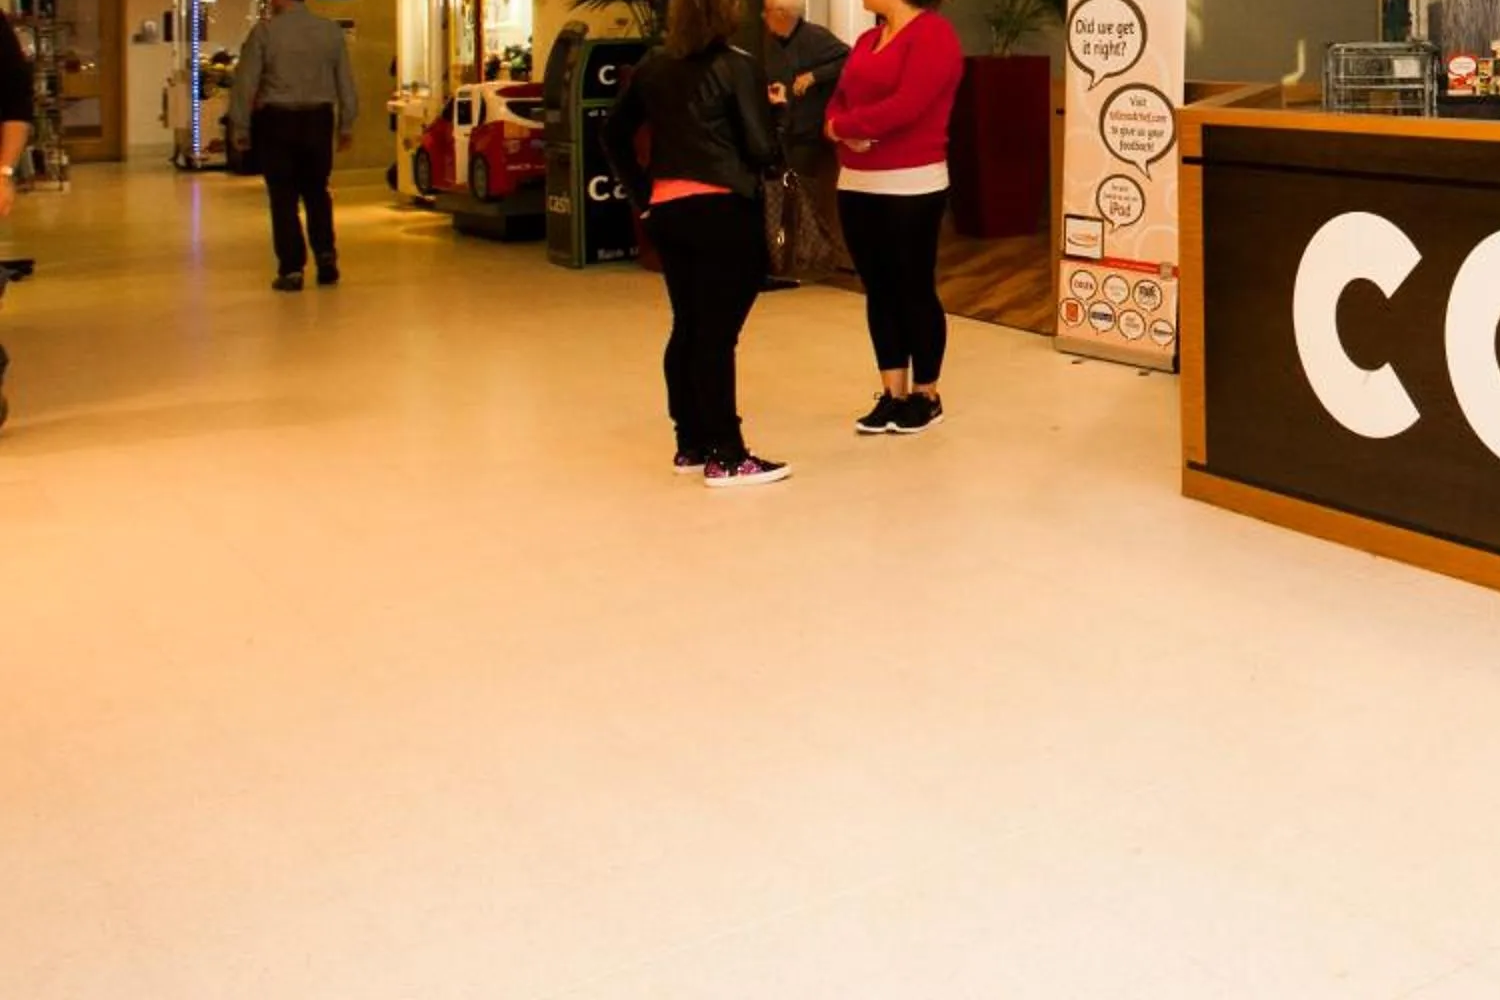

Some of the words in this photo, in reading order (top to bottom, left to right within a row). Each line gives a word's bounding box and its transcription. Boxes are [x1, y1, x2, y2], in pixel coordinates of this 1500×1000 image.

[1075, 19, 1095, 35] Did
[1098, 23, 1113, 35] we
[1115, 21, 1135, 39] get
[1083, 40, 1091, 55] it
[1094, 40, 1126, 60] right?
